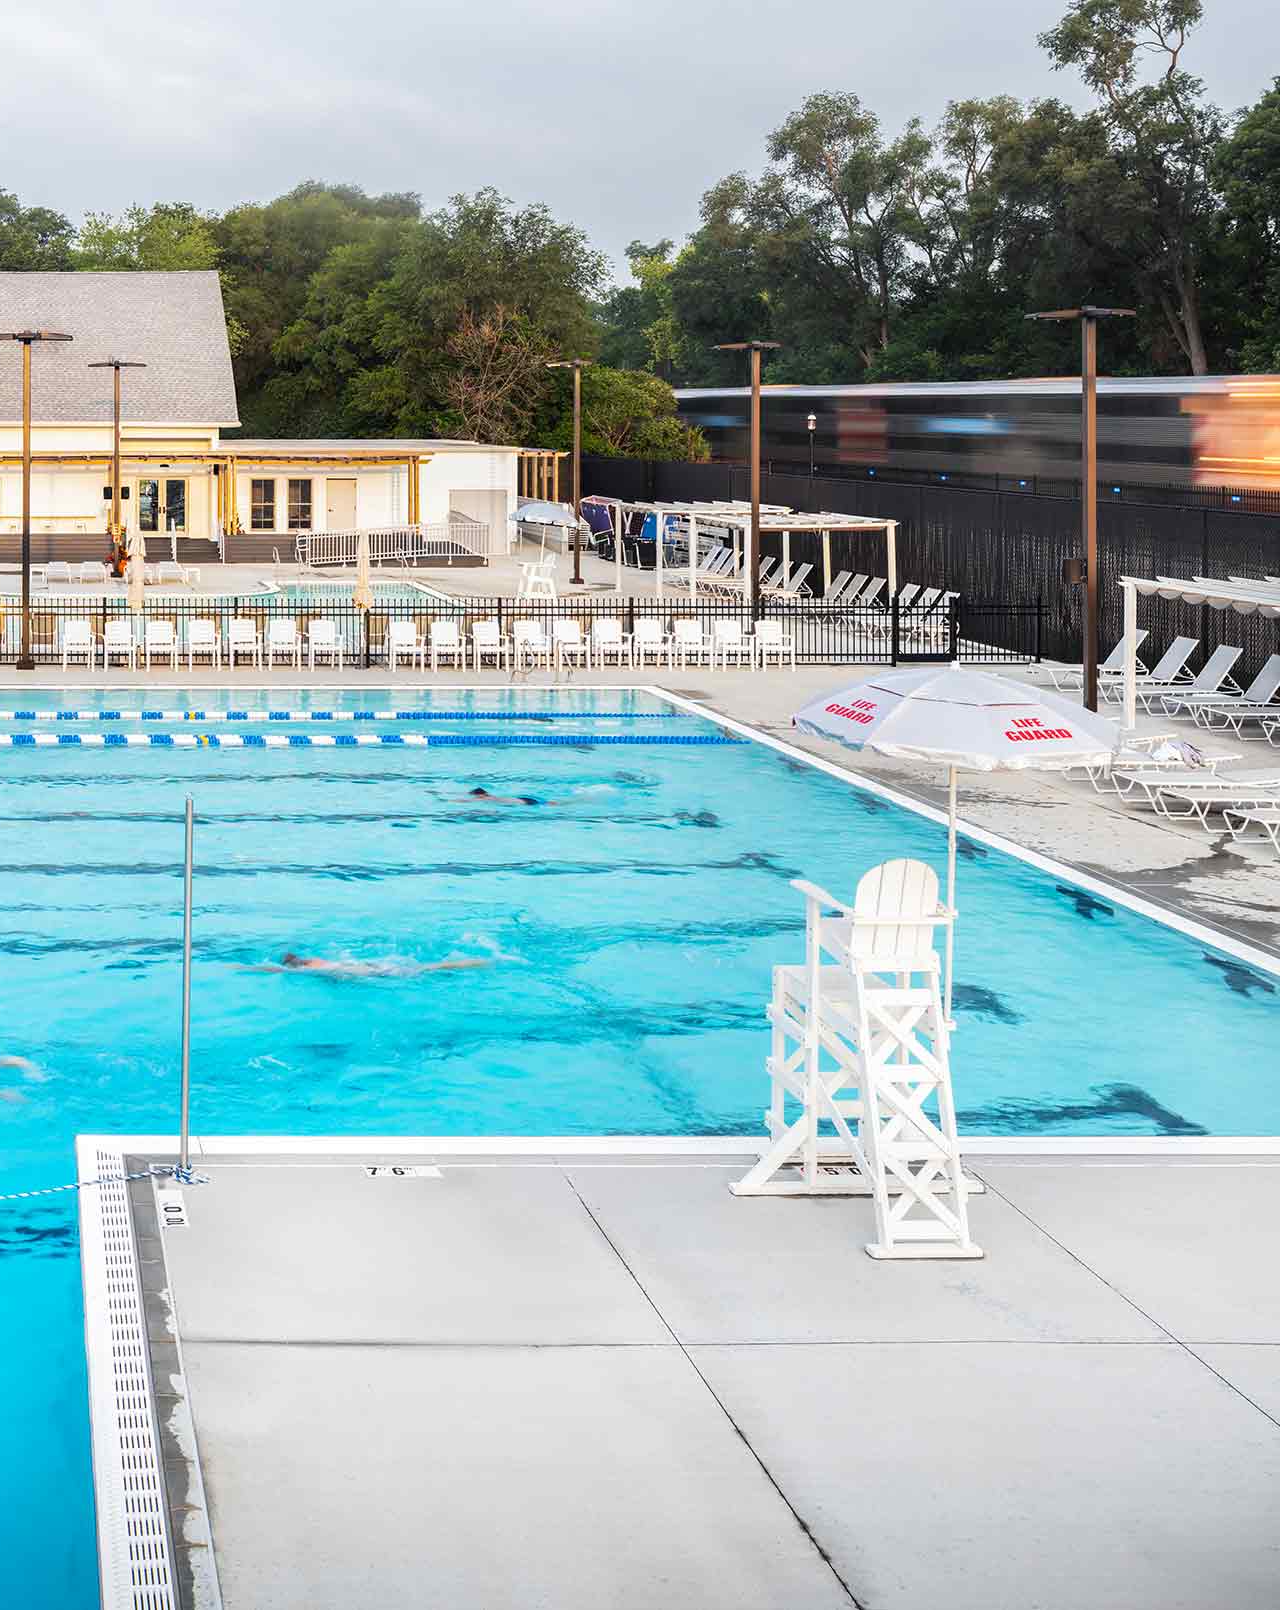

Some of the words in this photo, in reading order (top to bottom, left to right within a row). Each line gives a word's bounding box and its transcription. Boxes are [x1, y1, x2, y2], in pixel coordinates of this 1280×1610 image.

[851, 699, 878, 711] LIFE
[824, 703, 875, 725] GUARD
[1011, 717, 1045, 728] LIFE
[1005, 728, 1073, 741] GUARD
